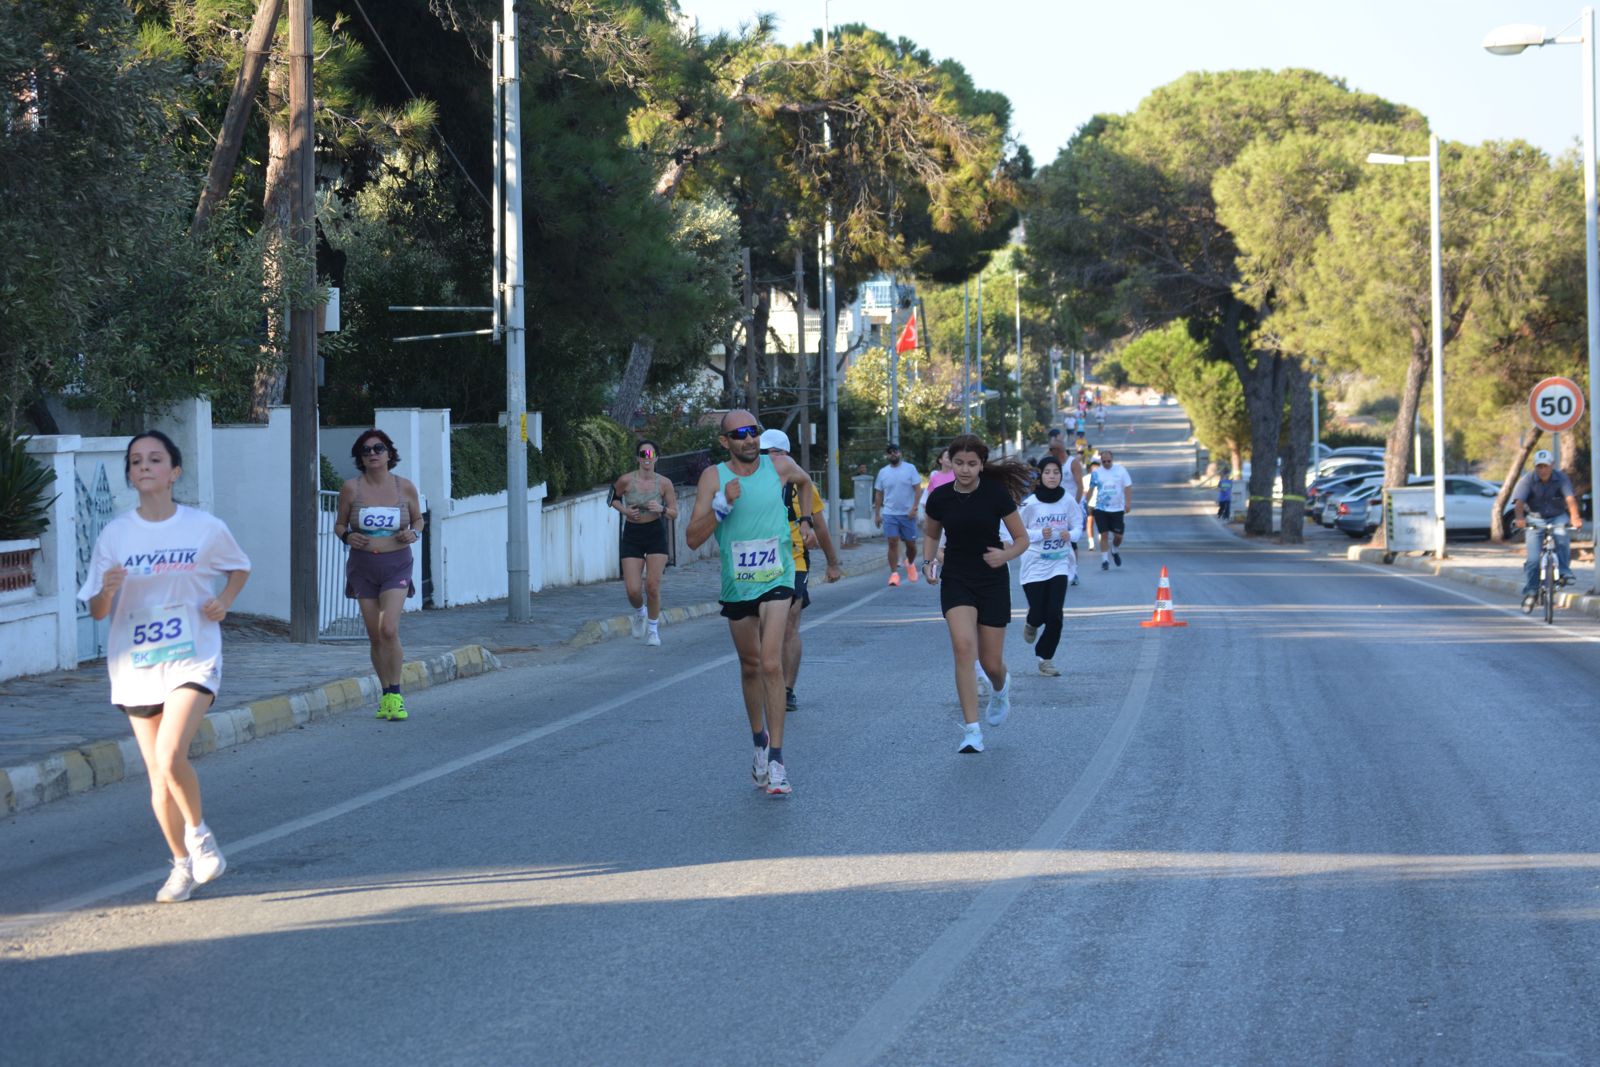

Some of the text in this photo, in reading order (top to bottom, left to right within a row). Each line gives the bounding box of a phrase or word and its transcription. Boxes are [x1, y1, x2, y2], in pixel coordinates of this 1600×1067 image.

[1540, 396, 1573, 417] 50
[363, 514, 395, 527] 631
[124, 551, 198, 567] AYVALIK
[737, 548, 776, 567] 1174
[736, 572, 756, 580] 10K
[133, 617, 182, 645] 533
